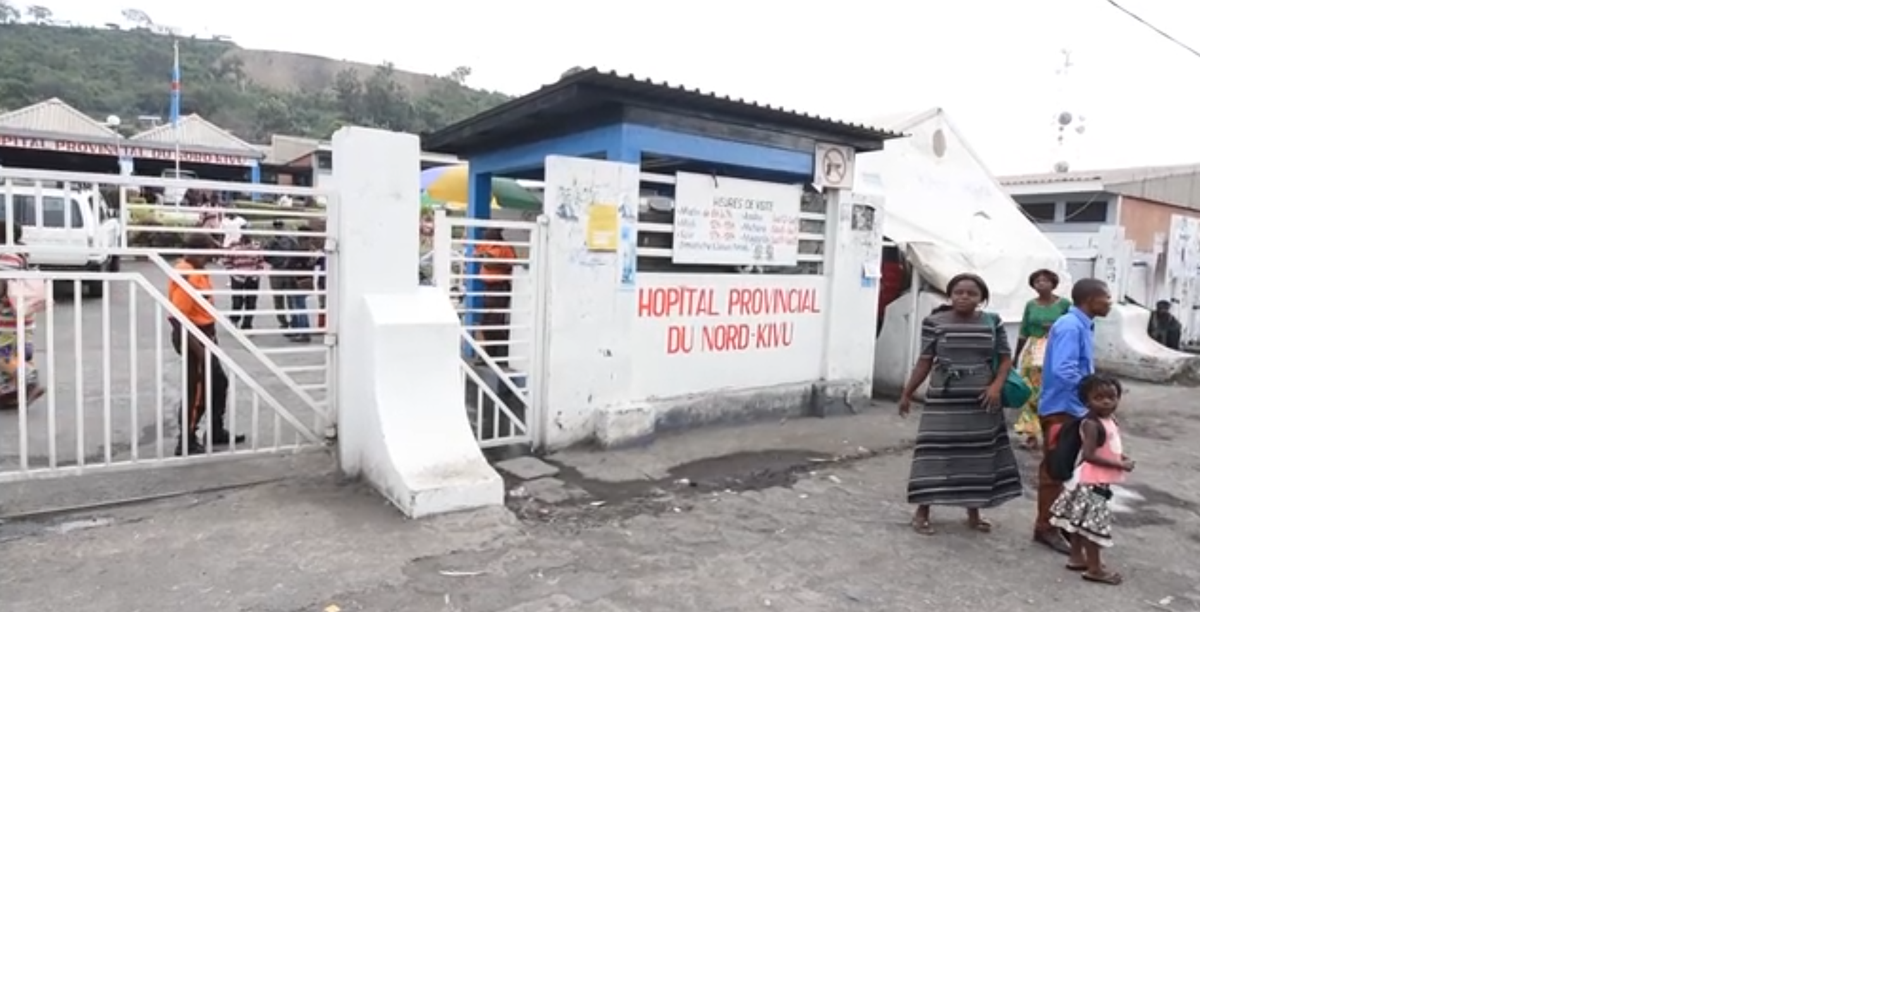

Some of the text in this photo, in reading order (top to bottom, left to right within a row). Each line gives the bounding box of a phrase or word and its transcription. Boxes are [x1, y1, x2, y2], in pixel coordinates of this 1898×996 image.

[713, 196, 743, 210] HEURES
[745, 199, 755, 209] DE
[728, 288, 821, 316] PROVINCIAL
[667, 321, 794, 354] DU NORD-KIVU
